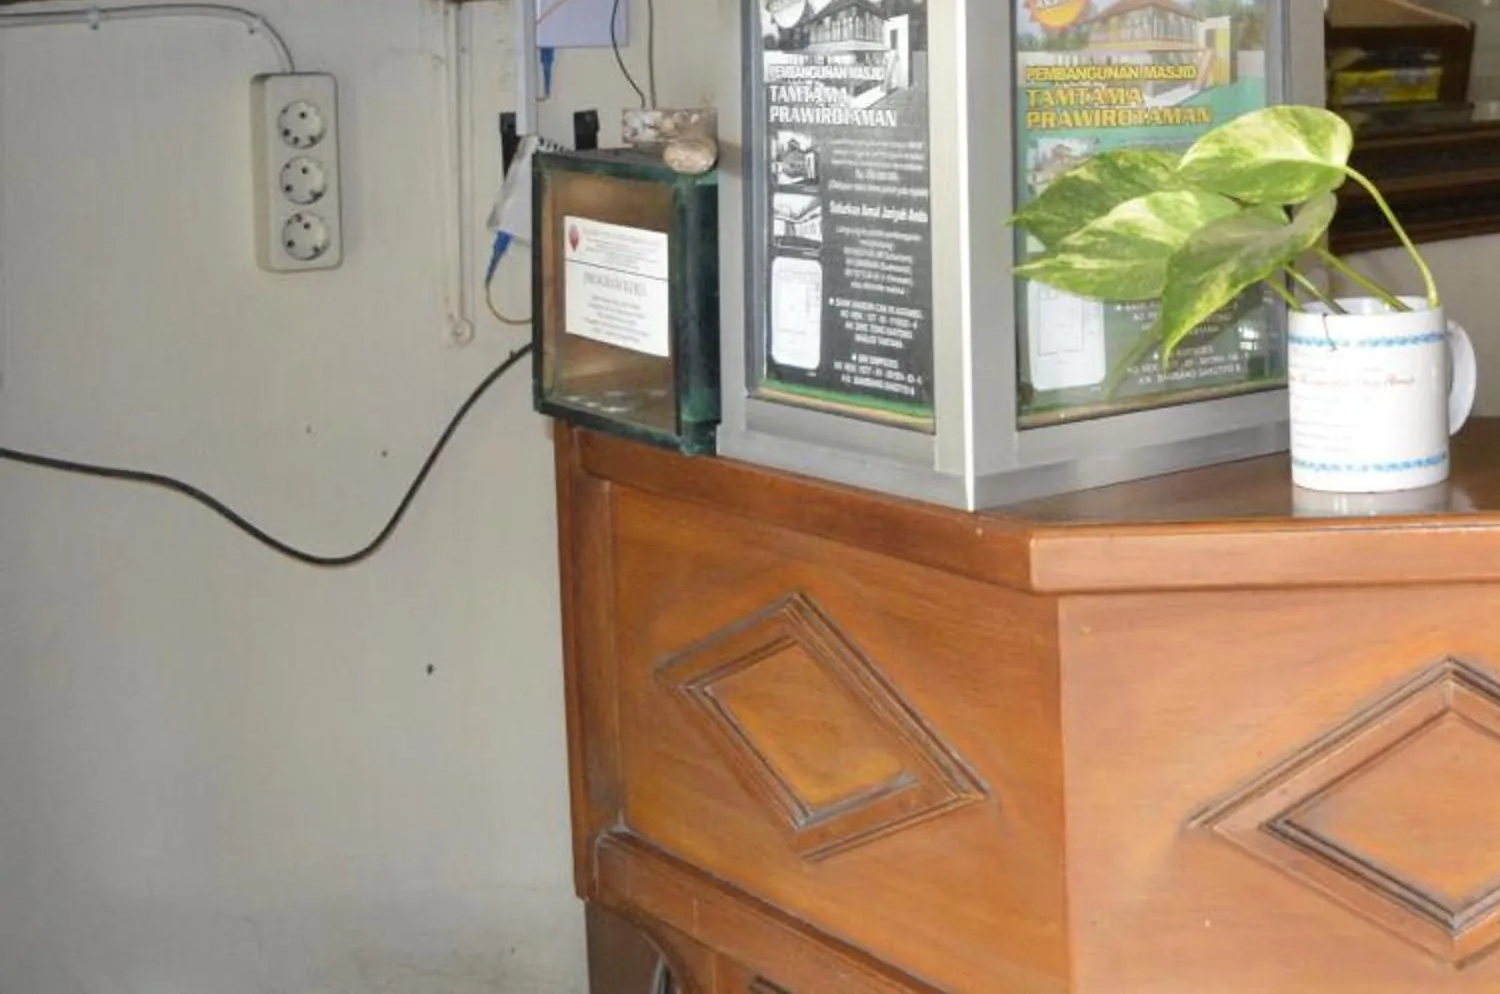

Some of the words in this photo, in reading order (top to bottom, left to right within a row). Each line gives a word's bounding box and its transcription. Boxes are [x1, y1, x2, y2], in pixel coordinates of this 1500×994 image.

[1026, 66, 1139, 80] PEMBANGUNAN
[1142, 66, 1197, 80] MASJID
[1026, 87, 1142, 108] TAMTAMA
[1026, 108, 1211, 130] PRAWIROTAMAN
